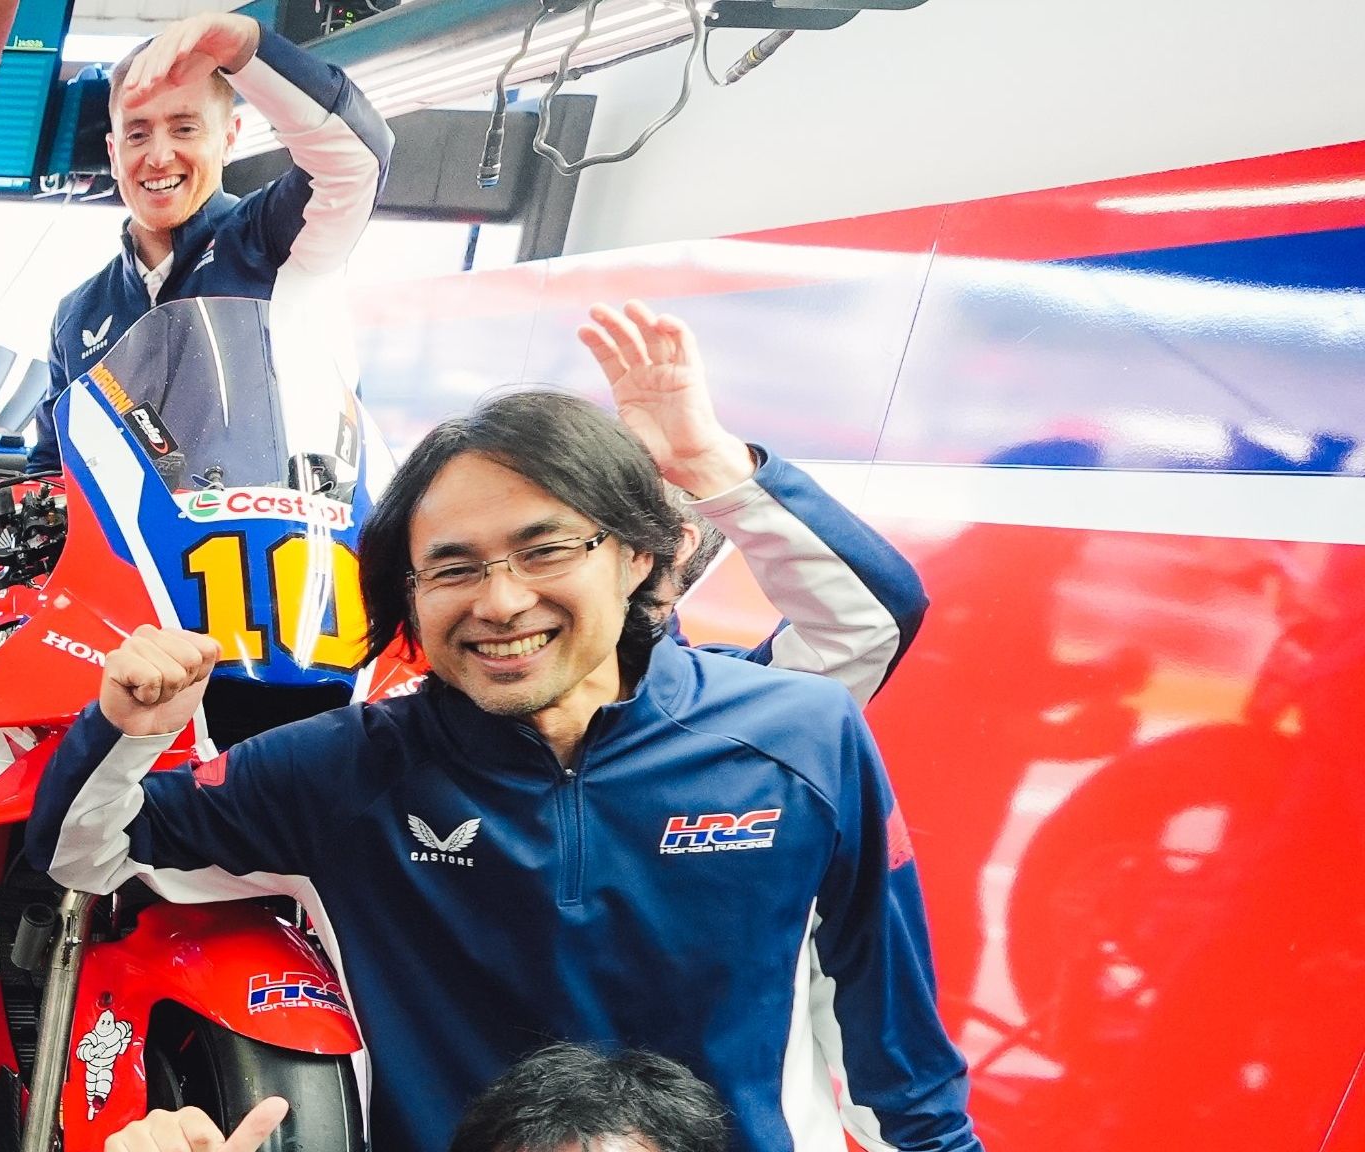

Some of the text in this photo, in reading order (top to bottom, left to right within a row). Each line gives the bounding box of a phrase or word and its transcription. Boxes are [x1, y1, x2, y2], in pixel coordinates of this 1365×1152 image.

[89, 362, 135, 414] MARINI
[183, 530, 371, 673] 10
[40, 630, 107, 669] HON
[660, 808, 782, 849] HRC
[660, 840, 773, 855] Honda RACING
[409, 851, 474, 867] CASTORE
[248, 1000, 310, 1016] Honda
